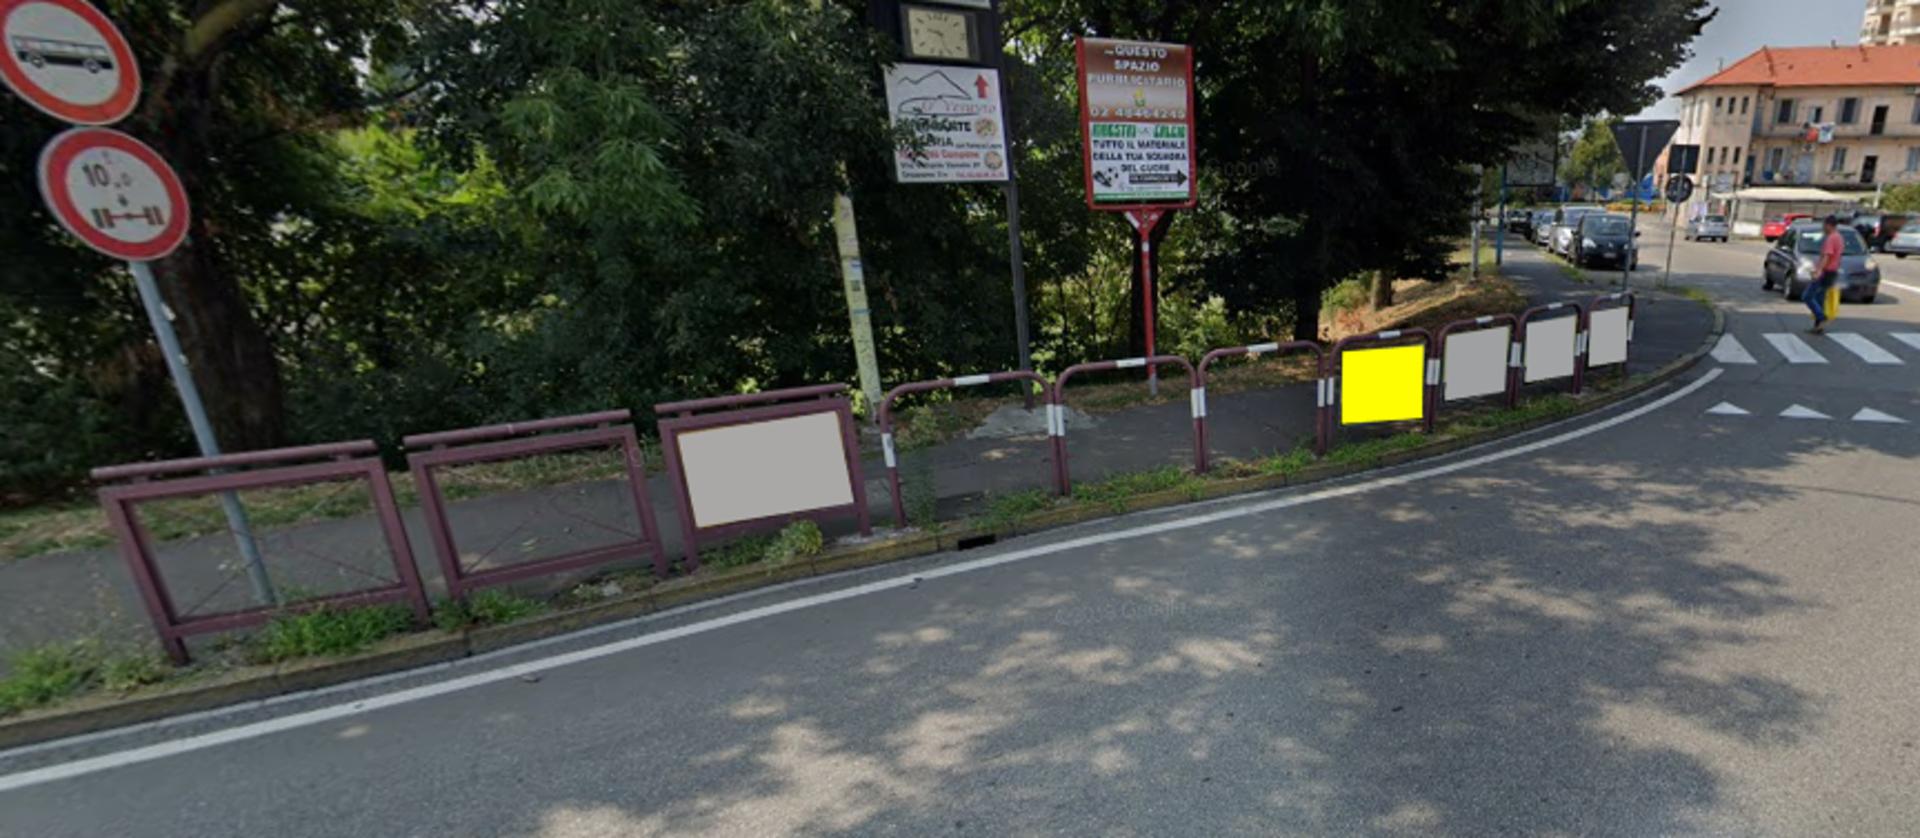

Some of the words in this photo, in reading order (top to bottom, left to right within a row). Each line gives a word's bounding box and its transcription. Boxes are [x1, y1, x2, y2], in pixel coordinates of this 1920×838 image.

[1114, 59, 1160, 72] SPAZIO
[1091, 108, 1109, 118] 02
[1093, 140, 1125, 149] TUTTO
[1126, 141, 1136, 149] IL
[1137, 140, 1185, 150] MATERIALE
[1093, 152, 1123, 161] DELLA
[1126, 152, 1144, 161] TUA
[1145, 152, 1187, 161] SQUADRA
[1120, 164, 1137, 172] DEL
[1139, 164, 1170, 172] CUORE
